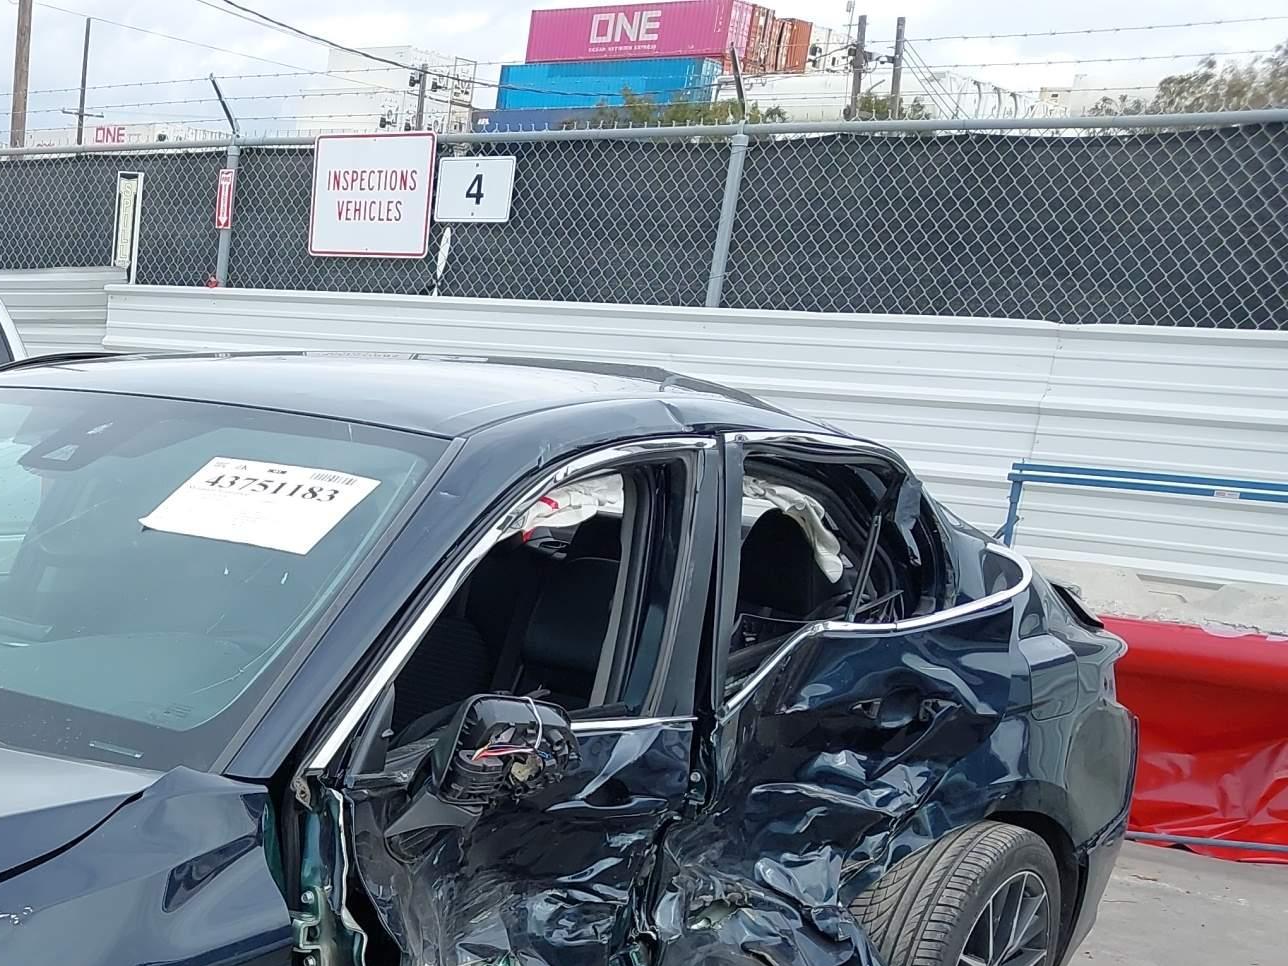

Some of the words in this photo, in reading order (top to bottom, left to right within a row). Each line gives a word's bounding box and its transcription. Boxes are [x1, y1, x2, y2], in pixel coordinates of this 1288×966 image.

[589, 10, 662, 43] ONE
[95, 127, 125, 143] ONE
[327, 169, 418, 191] INSPECTIONS
[465, 173, 484, 205] 4
[119, 183, 133, 259] SPILL
[337, 200, 403, 222] VEHICLES
[205, 474, 340, 502] 43751183
